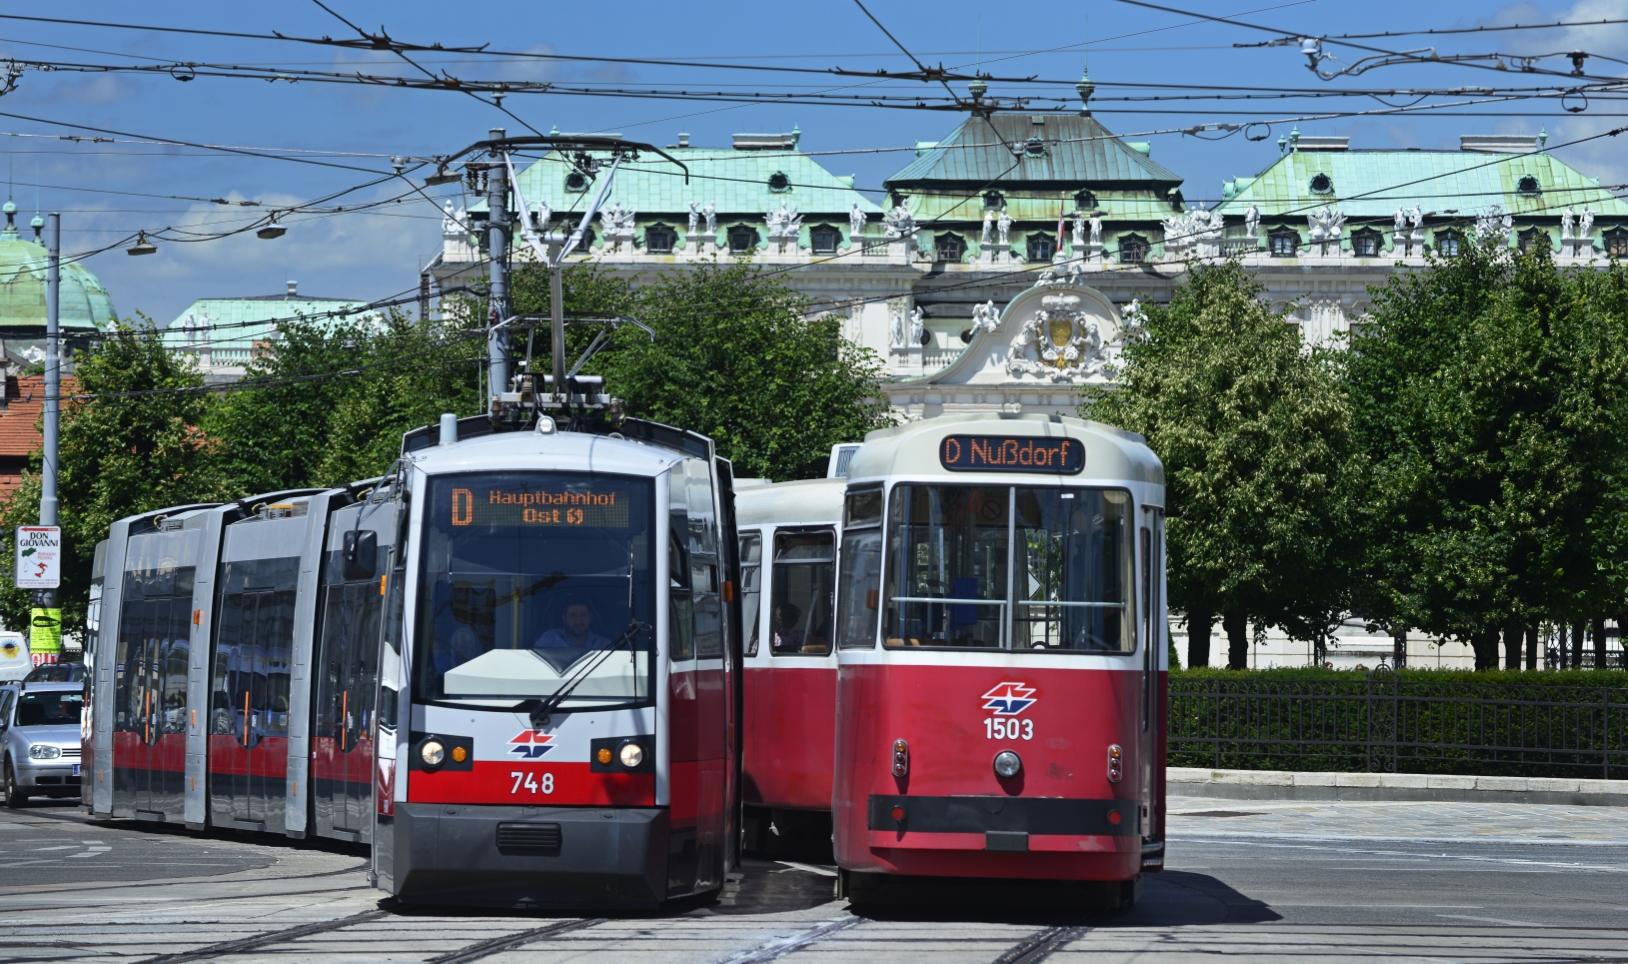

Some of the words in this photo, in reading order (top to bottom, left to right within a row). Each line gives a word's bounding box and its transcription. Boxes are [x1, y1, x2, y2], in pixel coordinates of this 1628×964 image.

[945, 438, 961, 463] D
[970, 438, 1071, 466] Nußdorf
[452, 488, 473, 526] D
[489, 490, 616, 507] Hauptbahnhof
[522, 508, 561, 523] Ost
[20, 539, 59, 547] GIOVANNI
[30, 532, 48, 540] DON
[983, 717, 1034, 741] 1503
[510, 772, 554, 795] 748
